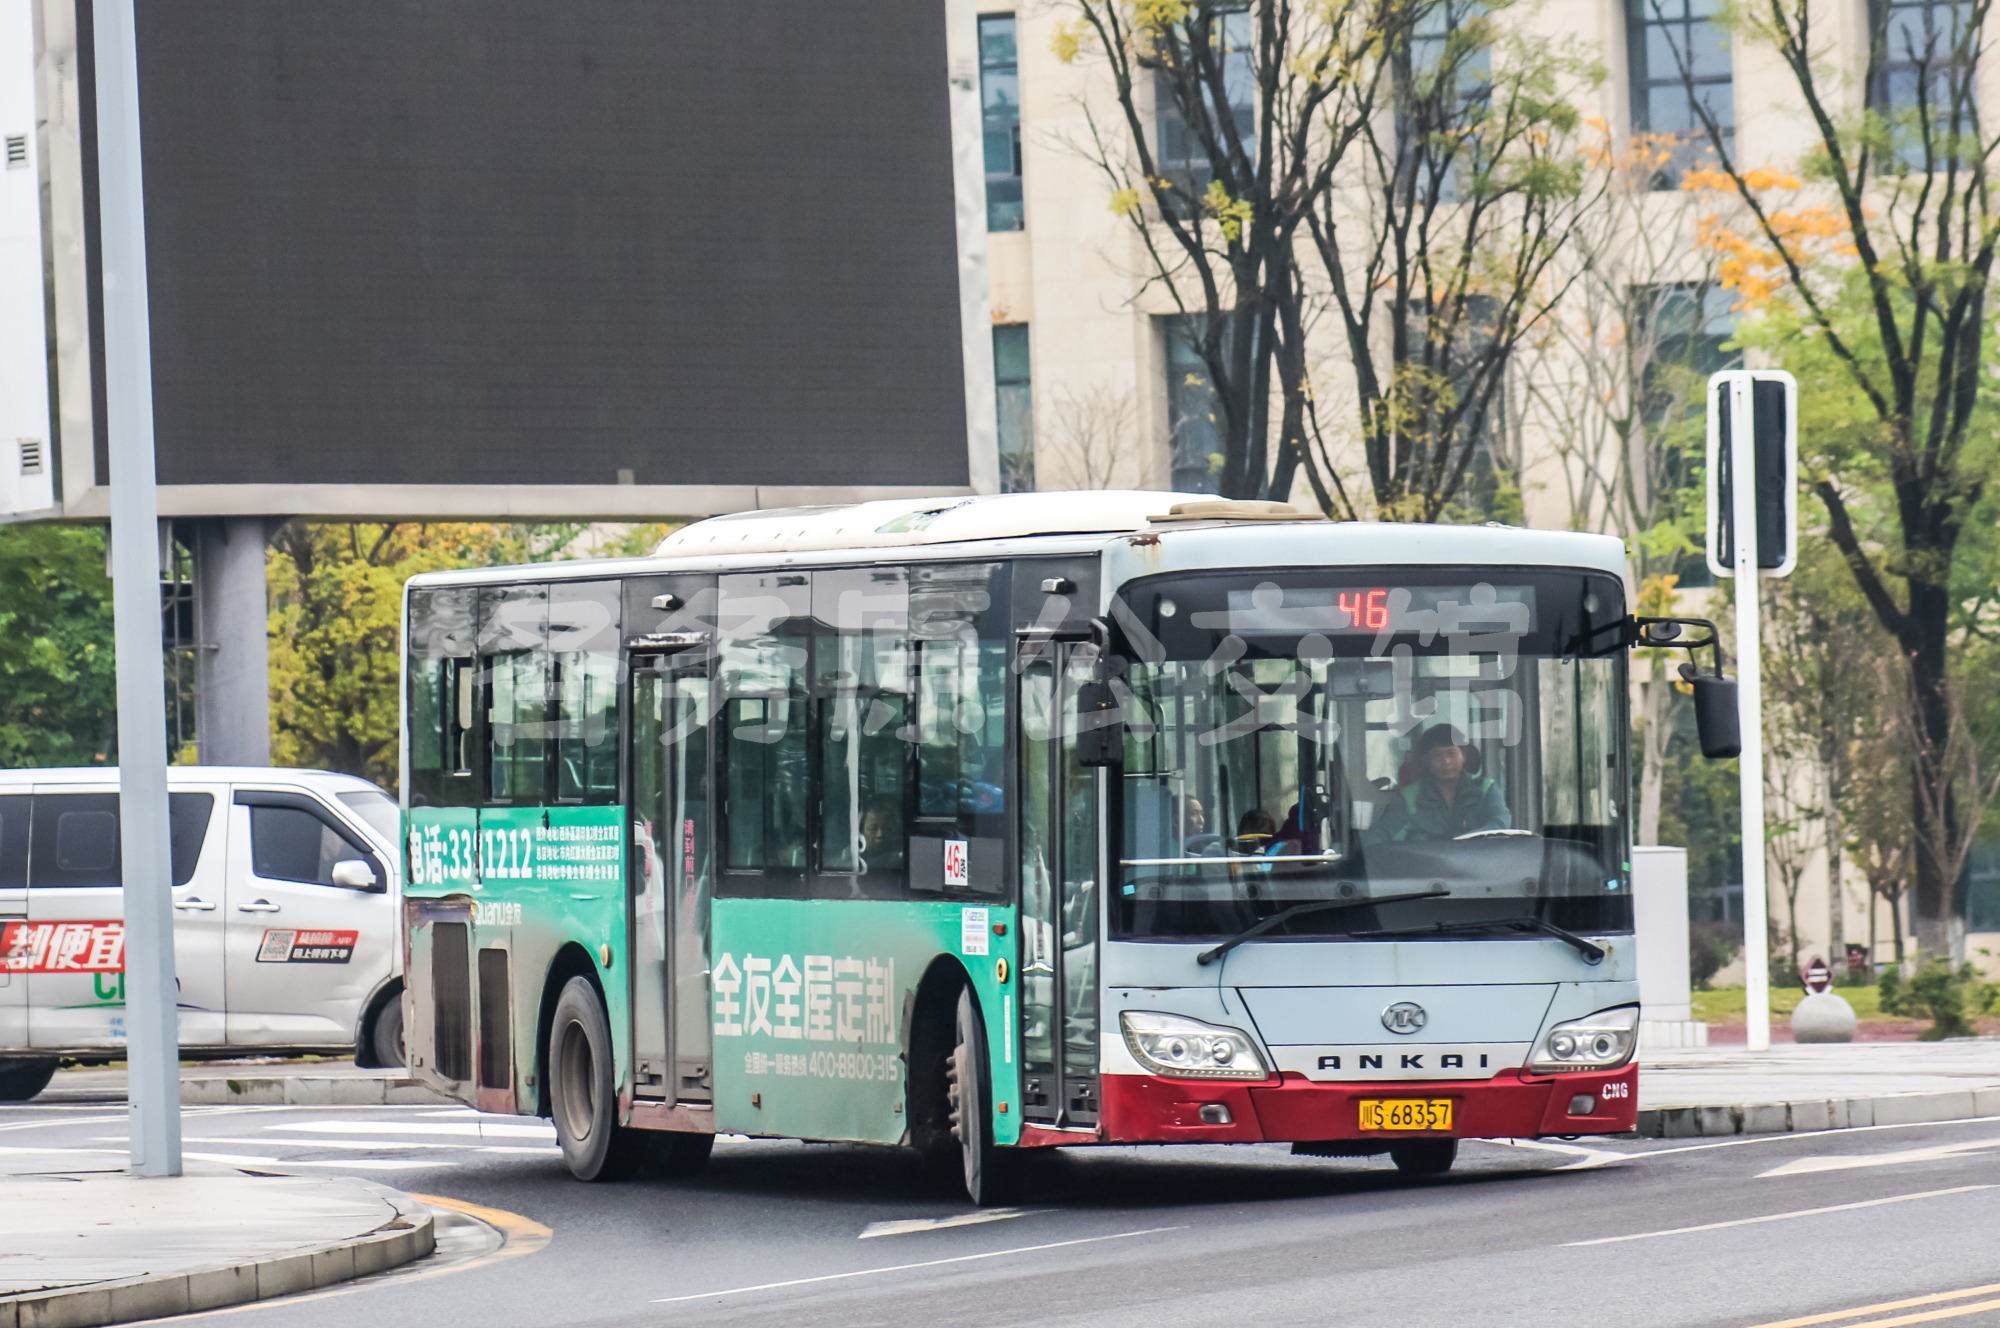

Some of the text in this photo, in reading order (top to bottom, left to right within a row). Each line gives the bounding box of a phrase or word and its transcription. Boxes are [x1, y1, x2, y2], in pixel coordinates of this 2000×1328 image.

[1339, 590, 1388, 629] 46
[6, 923, 125, 970] 都便宜
[712, 952, 896, 1044] 全友全屋定制
[744, 1052, 808, 1077] 全国统一服务热线
[1317, 1053, 1489, 1071] ANKAI
[1602, 1082, 1629, 1100] CNG
